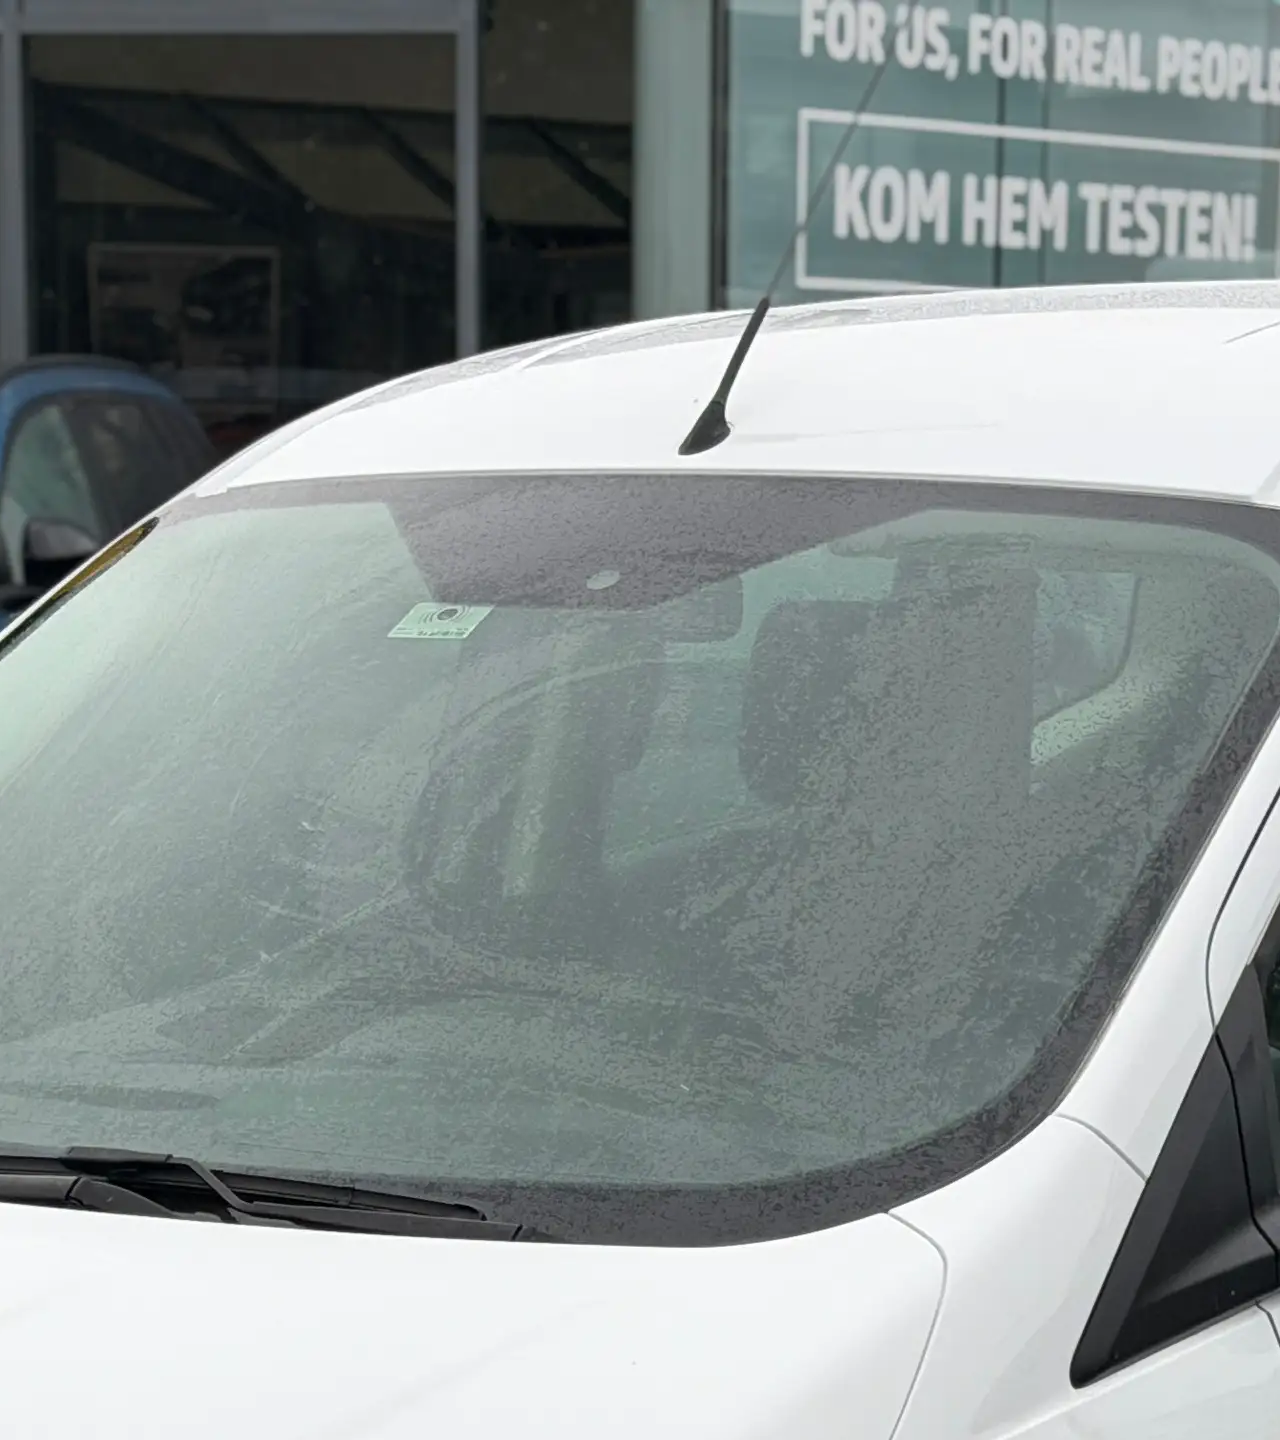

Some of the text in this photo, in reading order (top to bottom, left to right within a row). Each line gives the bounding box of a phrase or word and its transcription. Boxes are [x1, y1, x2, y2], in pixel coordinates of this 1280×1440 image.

[800, 0, 885, 64] FOR
[895, 7, 960, 81] US,
[967, 14, 1046, 82] FOR
[1053, 23, 1150, 93] REAL
[833, 162, 1258, 262] KOM HEM TESTEN!
